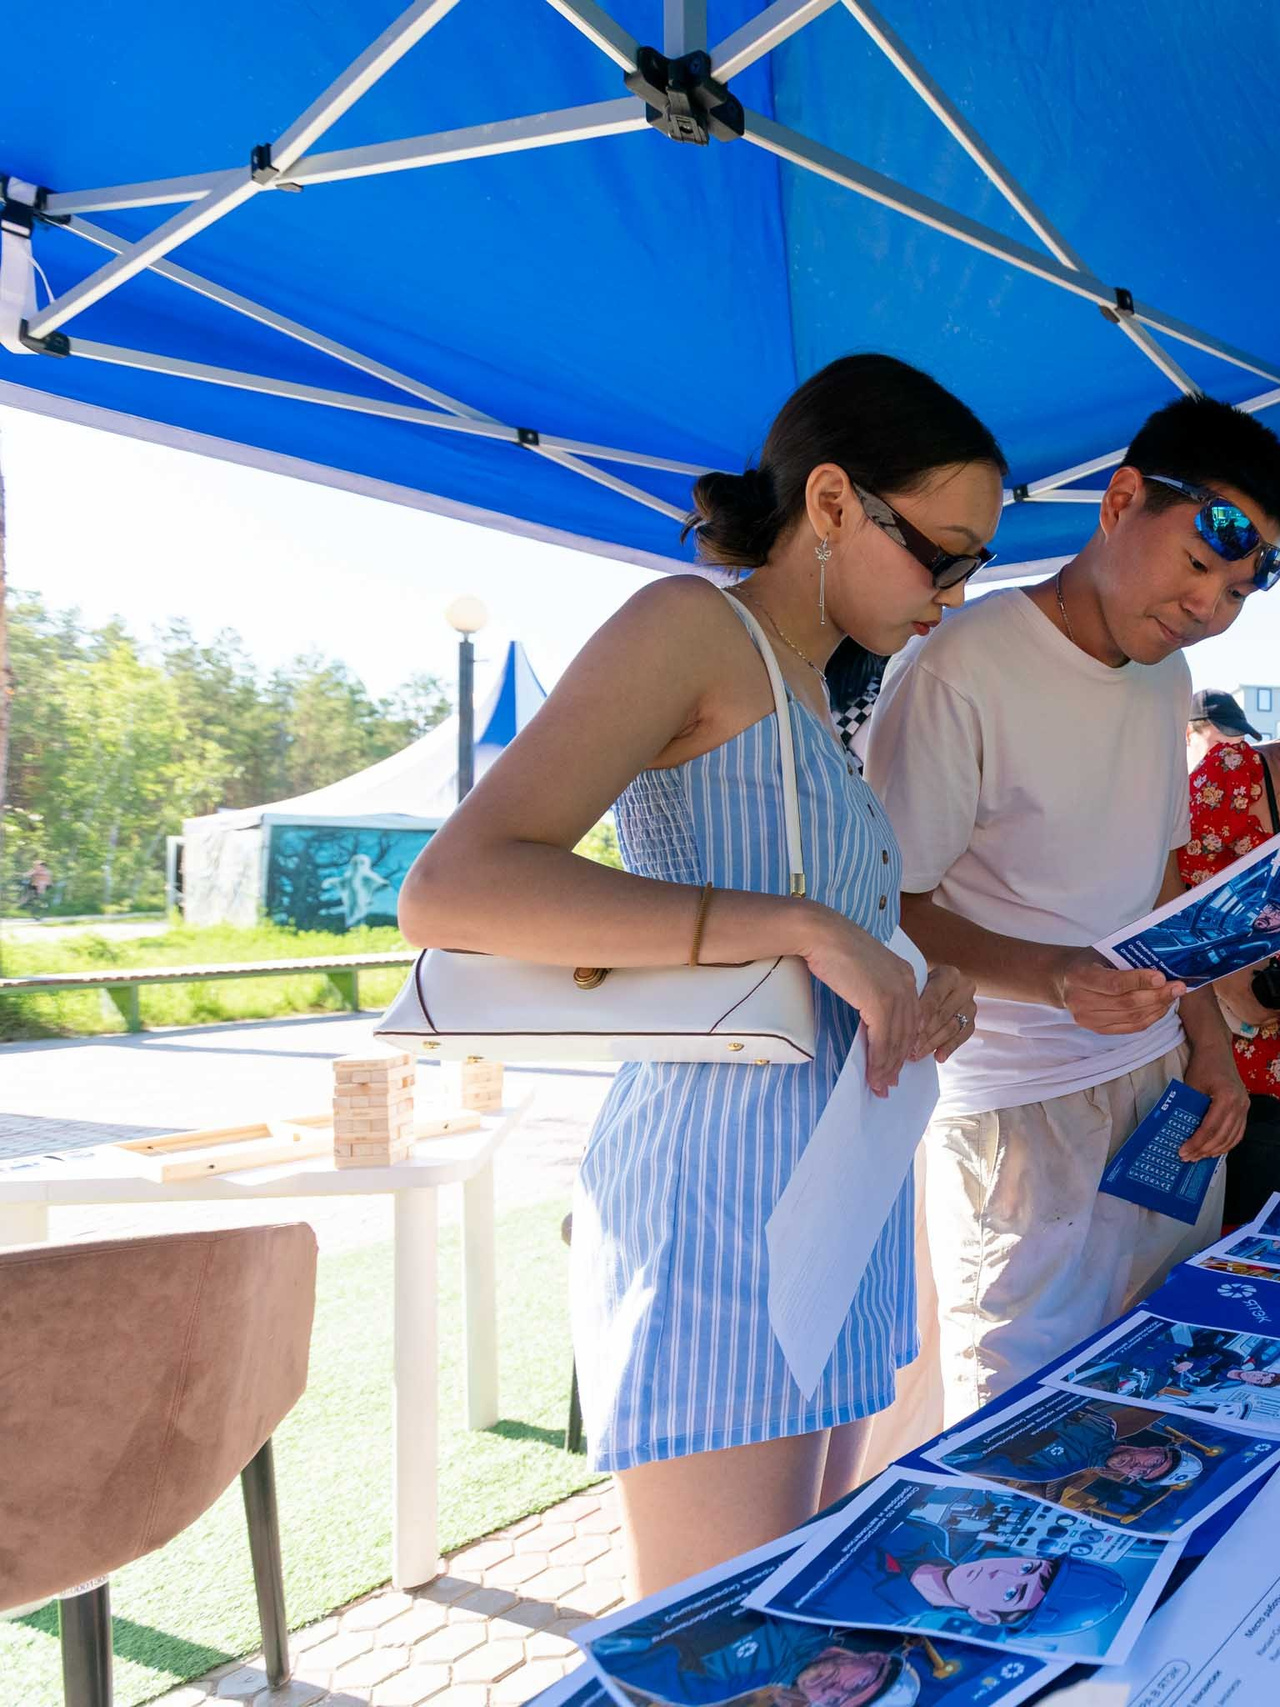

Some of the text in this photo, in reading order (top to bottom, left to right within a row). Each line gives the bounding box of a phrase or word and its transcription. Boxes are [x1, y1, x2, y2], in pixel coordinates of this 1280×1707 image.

[1161, 1090, 1176, 1110] ВТБ
[1243, 1299, 1272, 1323] ЯТЭК
[884, 1485, 912, 1512] приборам
[894, 1486, 920, 1509] Слесарь
[886, 1509, 896, 1518] по
[1244, 1616, 1266, 1638] Место
